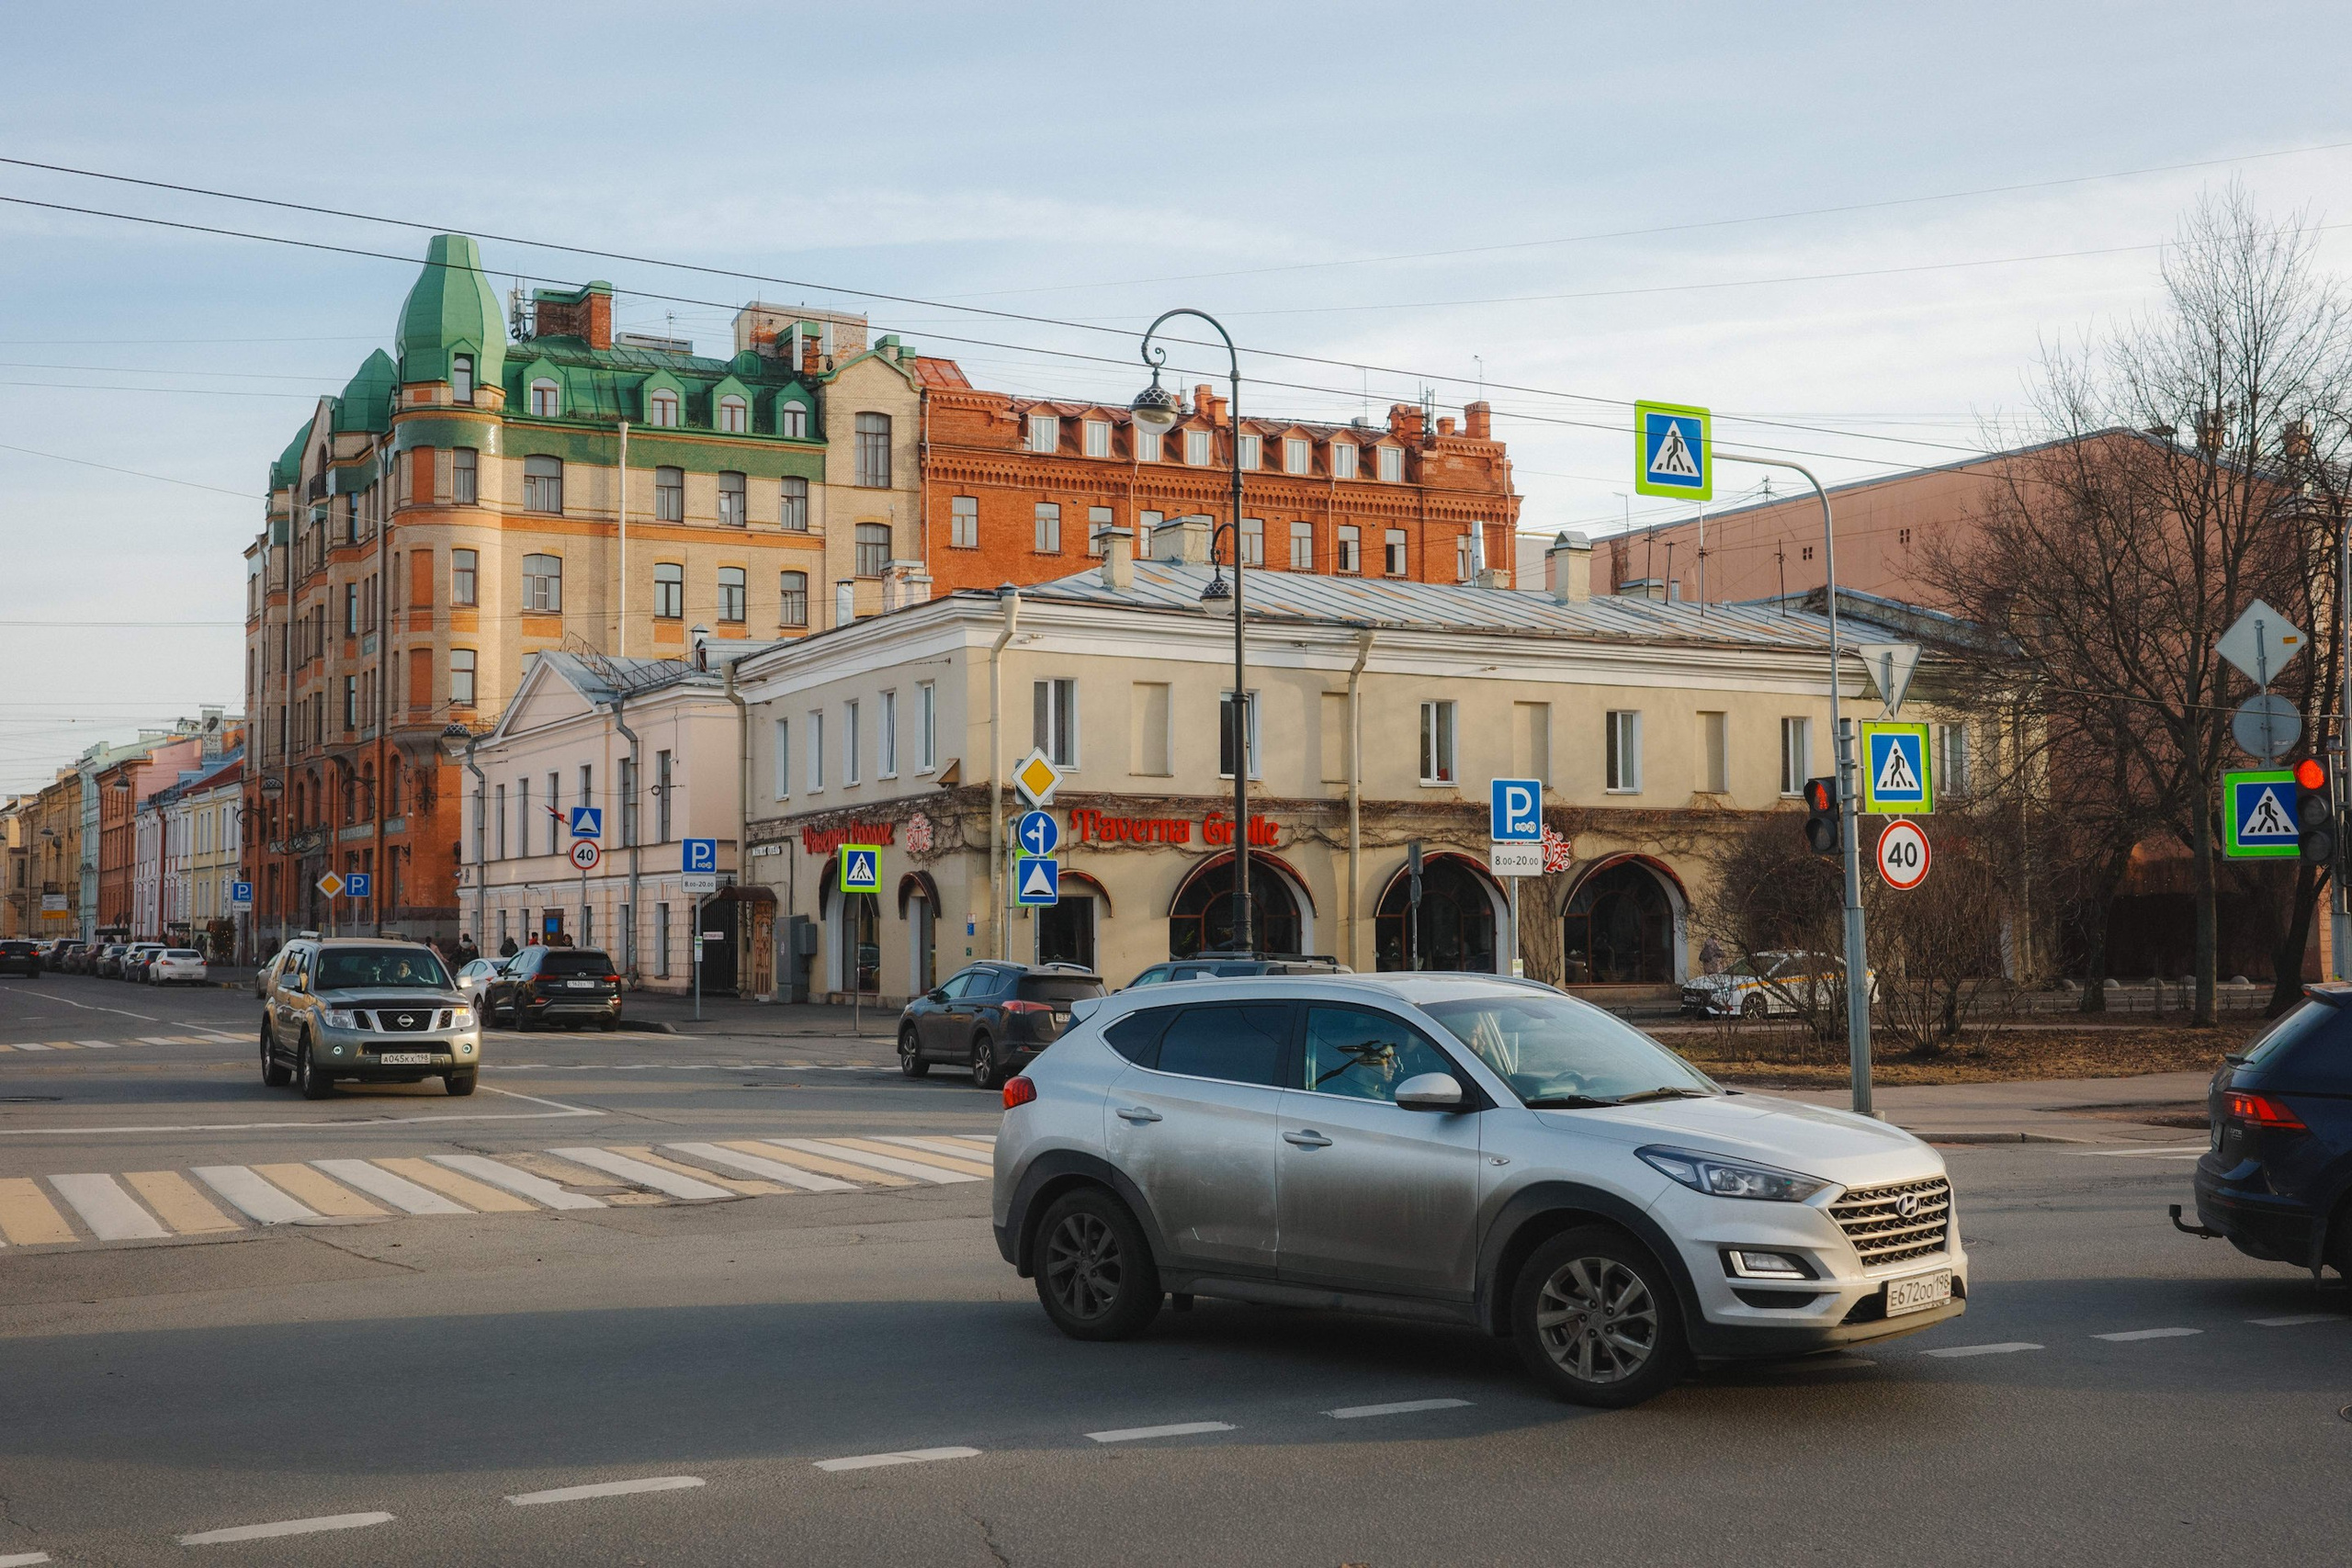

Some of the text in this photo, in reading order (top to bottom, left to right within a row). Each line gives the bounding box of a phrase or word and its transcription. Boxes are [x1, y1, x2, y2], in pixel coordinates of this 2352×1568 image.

[1506, 786, 1532, 834] P
[1070, 808, 1280, 846] Taverna Grlle
[577, 849, 594, 861] 40
[692, 842, 710, 869] P
[1495, 855, 1539, 865] 8.00-20.00
[1887, 841, 1917, 868] 40
[238, 885, 248, 898] P
[352, 876, 364, 894] P
[1934, 1273, 1950, 1292] 198
